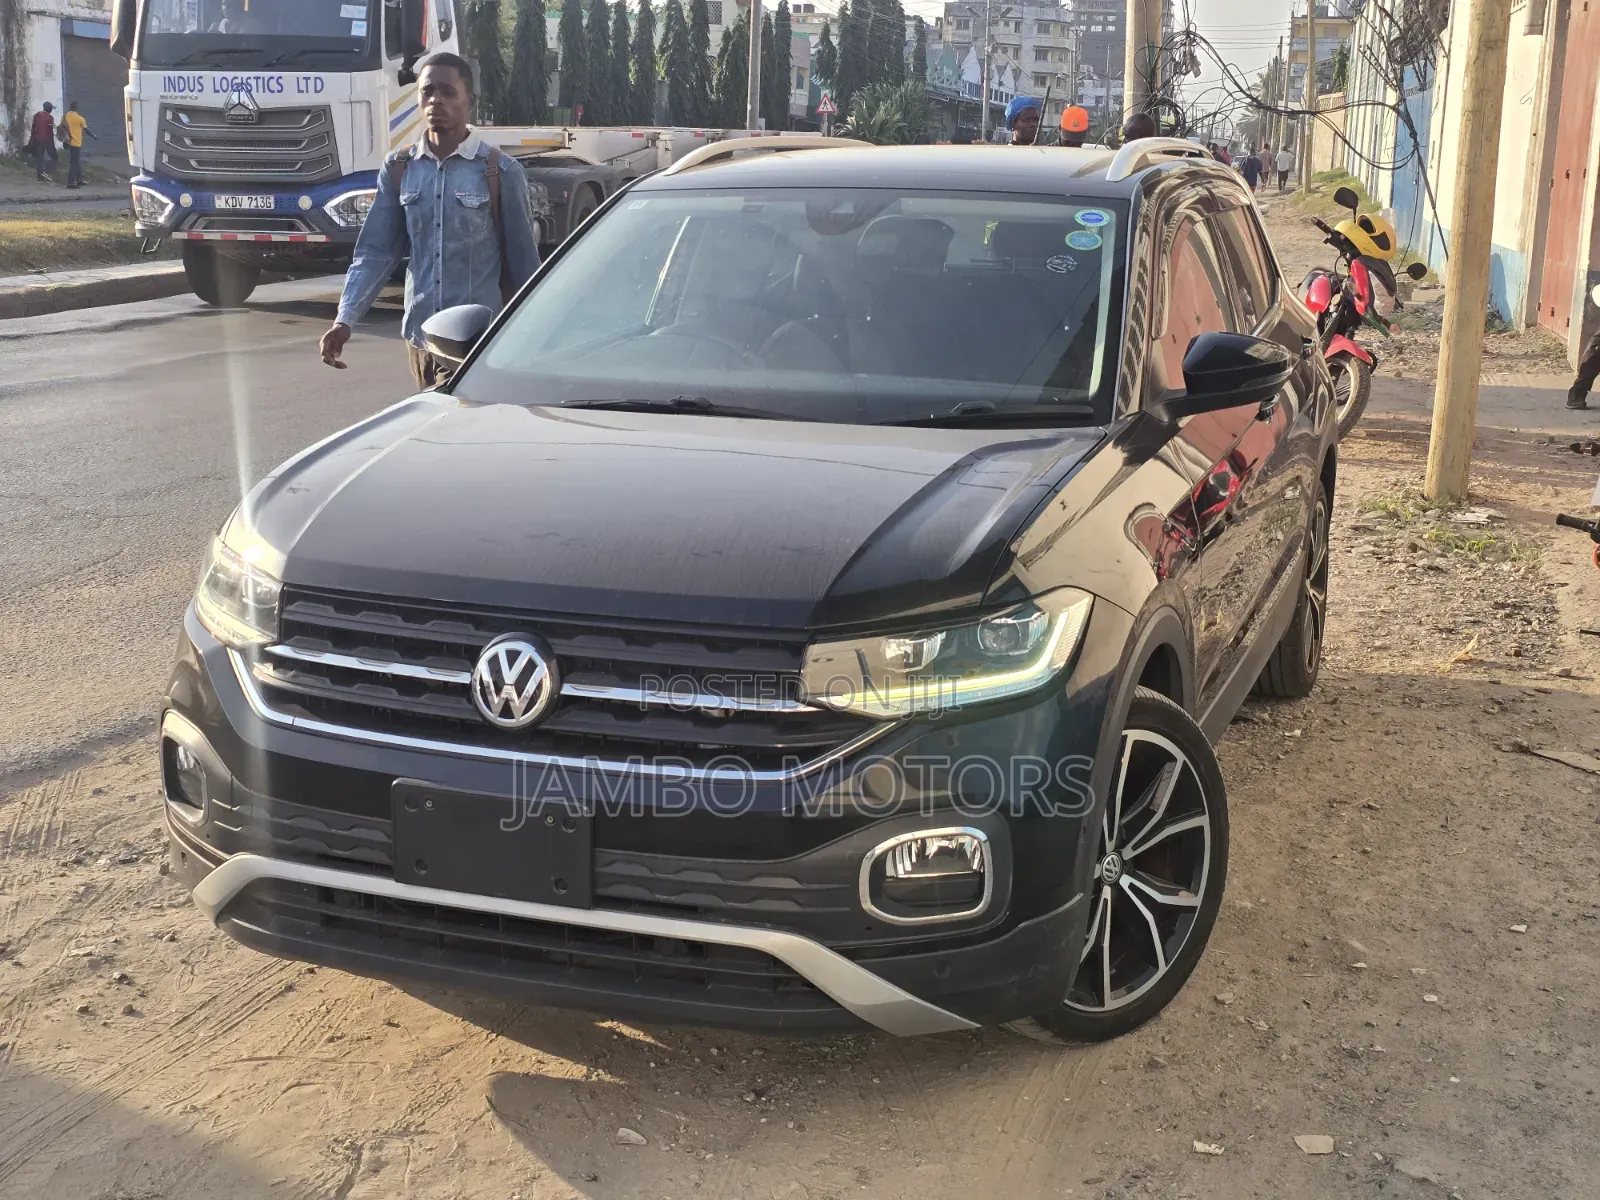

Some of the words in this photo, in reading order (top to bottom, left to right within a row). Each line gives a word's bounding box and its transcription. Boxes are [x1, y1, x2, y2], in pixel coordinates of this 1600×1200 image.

[163, 76, 204, 93] INDUS
[212, 76, 284, 93] LOGISTICS
[296, 76, 325, 94] LTD
[224, 196, 243, 208] KDV
[247, 196, 272, 209] 713G
[472, 640, 550, 727] VW
